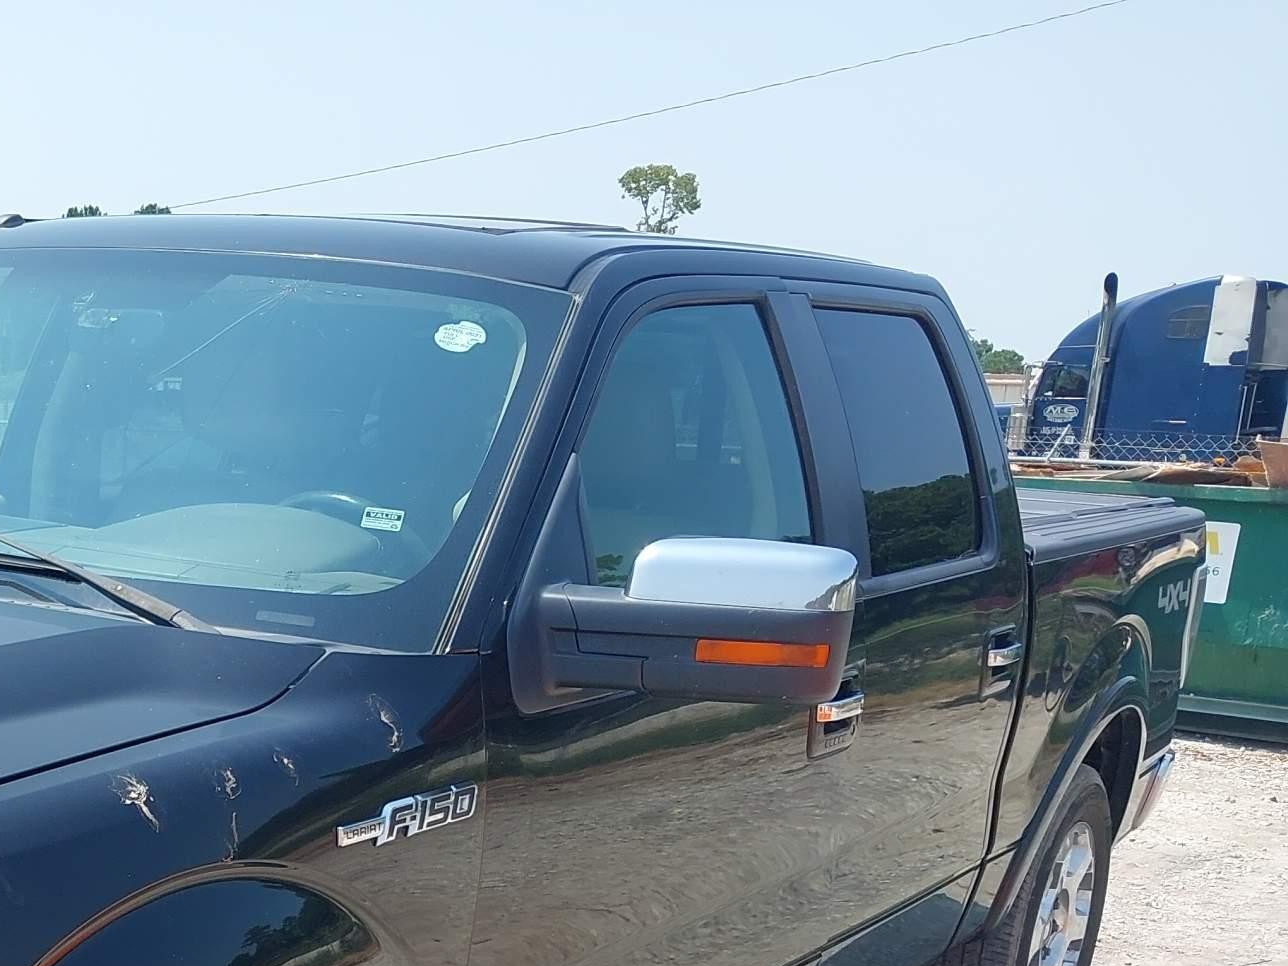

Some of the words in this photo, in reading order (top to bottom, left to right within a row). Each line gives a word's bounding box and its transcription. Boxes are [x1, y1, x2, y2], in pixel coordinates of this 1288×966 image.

[370, 512, 398, 520] VALID
[1158, 578, 1191, 614] 4X4
[345, 822, 382, 840] LARIAT
